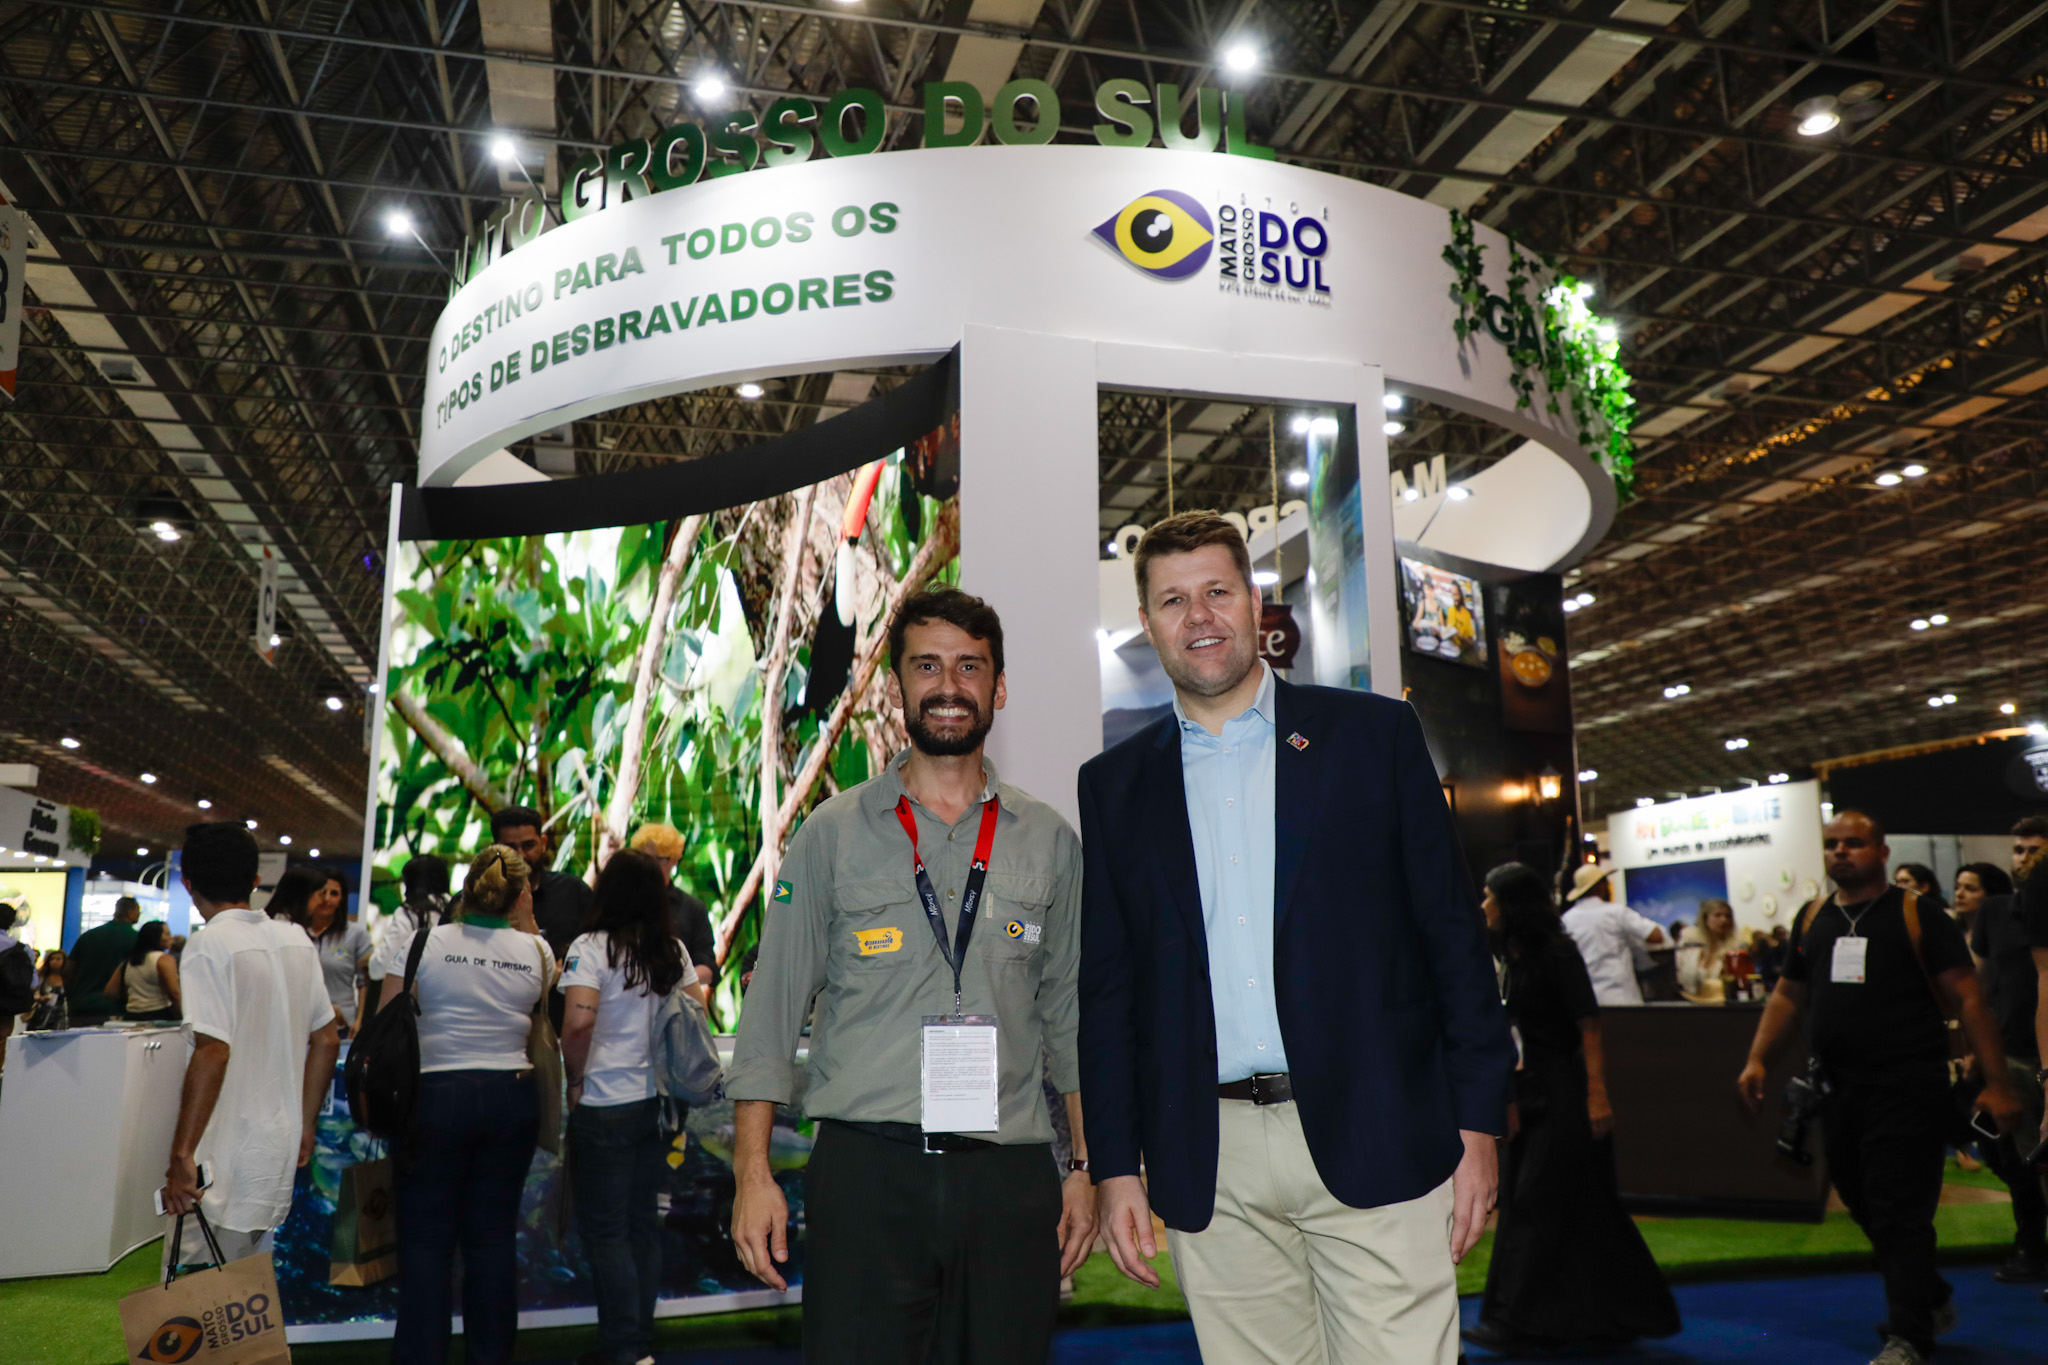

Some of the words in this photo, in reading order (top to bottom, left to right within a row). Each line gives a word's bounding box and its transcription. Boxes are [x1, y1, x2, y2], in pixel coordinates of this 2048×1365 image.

[561, 87, 888, 224] GROSSO
[923, 78, 1061, 149] DO
[1093, 78, 1275, 162] SUL
[1218, 204, 1238, 279] MATO
[1241, 207, 1256, 281] GROSSO
[1259, 210, 1329, 258] DO
[438, 346, 447, 374] O
[450, 280, 543, 363] DESTINO
[553, 246, 645, 300] PARA
[661, 211, 815, 265] TODOS
[831, 202, 900, 238] OS
[1260, 251, 1331, 293] SUL
[437, 371, 483, 429] TIPOS
[490, 350, 522, 392] DE
[530, 269, 896, 374] DESBRAVADORES
[444, 954, 468, 965] GUIA
[473, 957, 487, 967] DE
[492, 960, 532, 973] TURISMO
[202, 1310, 220, 1350] MATO
[215, 1306, 230, 1346] GROSSO
[224, 1293, 270, 1325] DO
[230, 1313, 275, 1342] SUL
